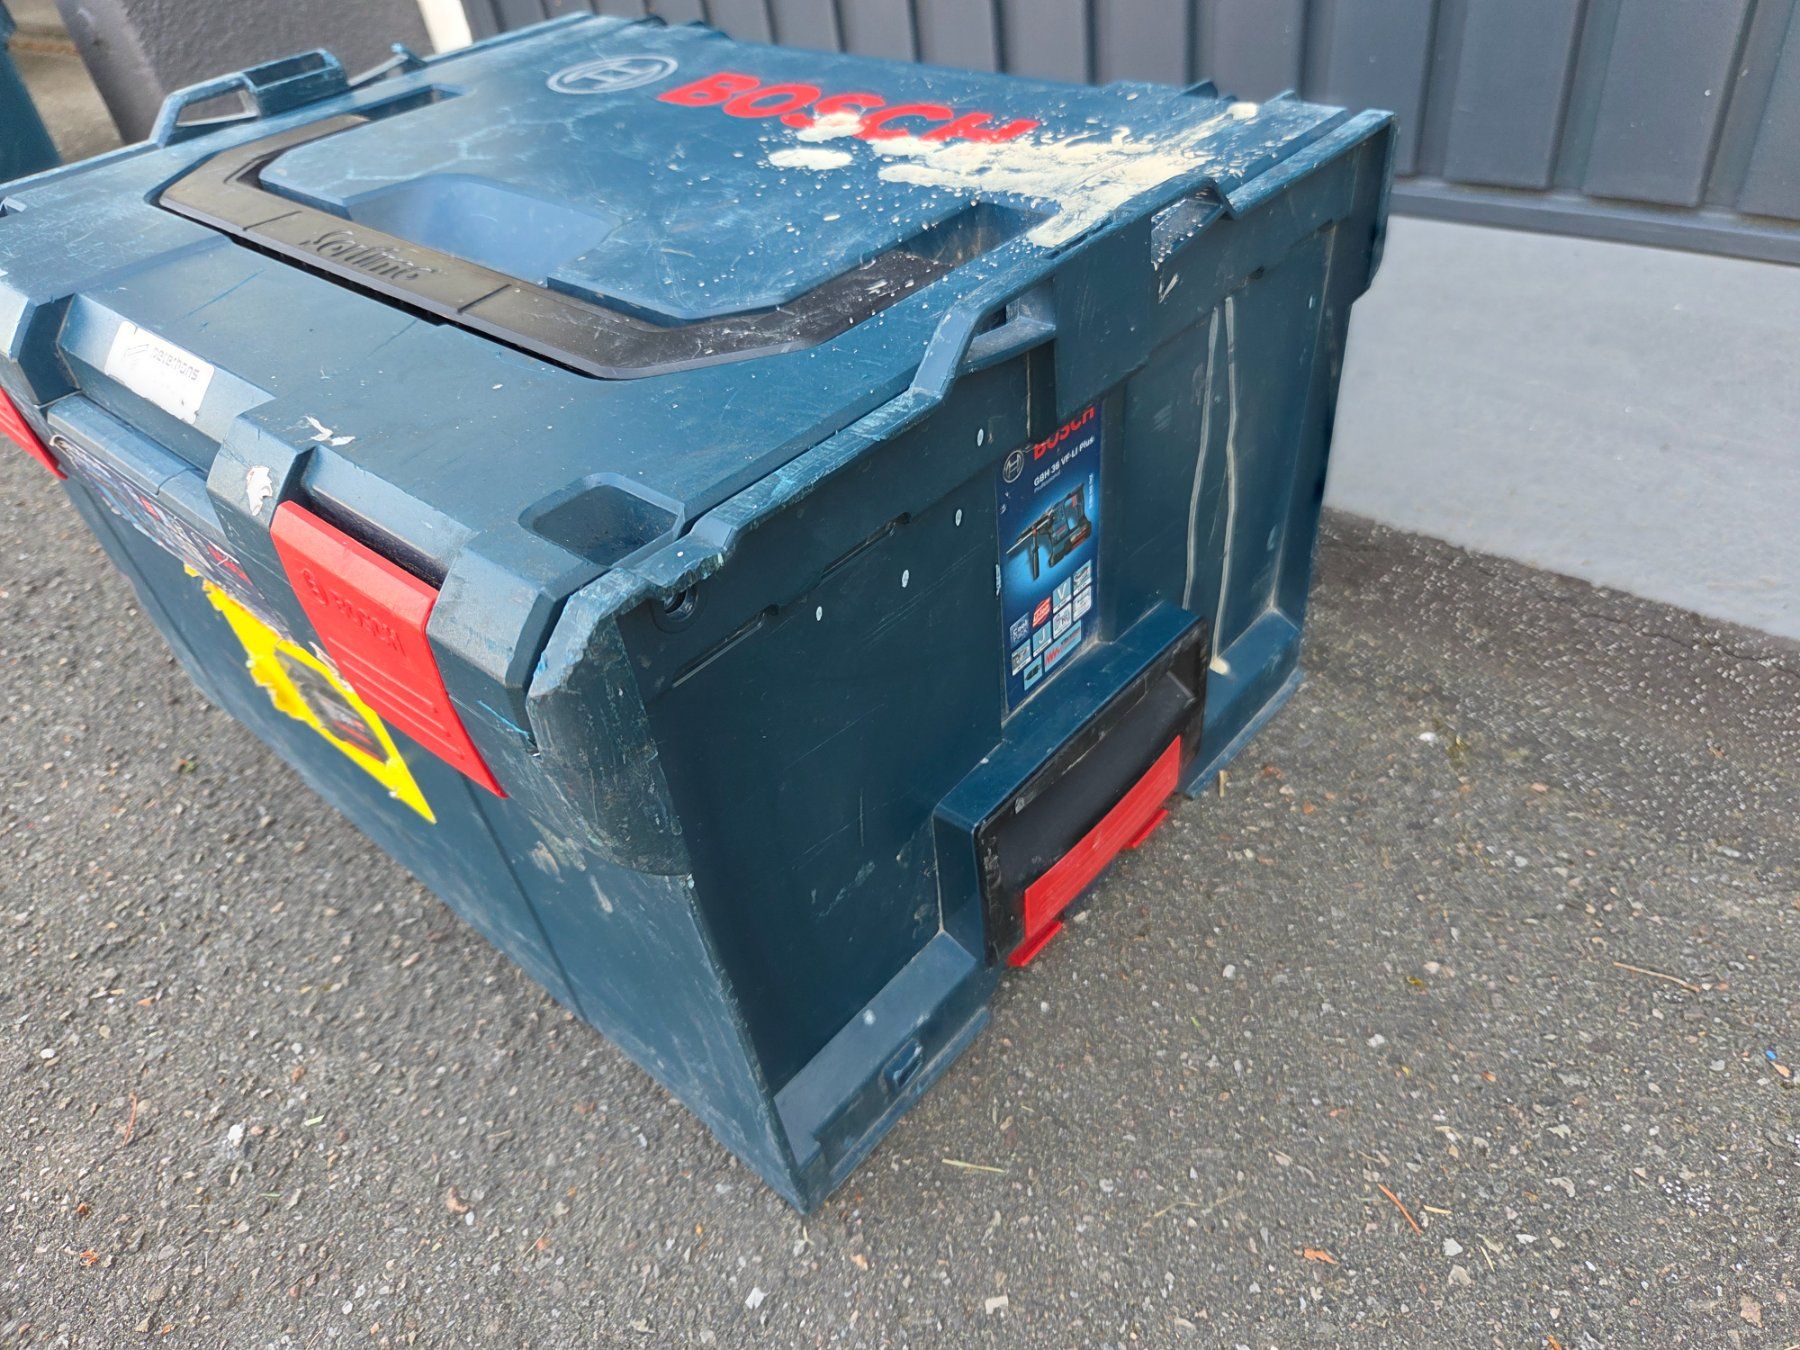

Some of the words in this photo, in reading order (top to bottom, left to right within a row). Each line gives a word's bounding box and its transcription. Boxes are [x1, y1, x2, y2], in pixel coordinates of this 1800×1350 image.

[657, 72, 1041, 144] BOSCH
[1033, 469, 1050, 487] GBH
[1079, 435, 1095, 453] Plus
[1057, 579, 1068, 601] V
